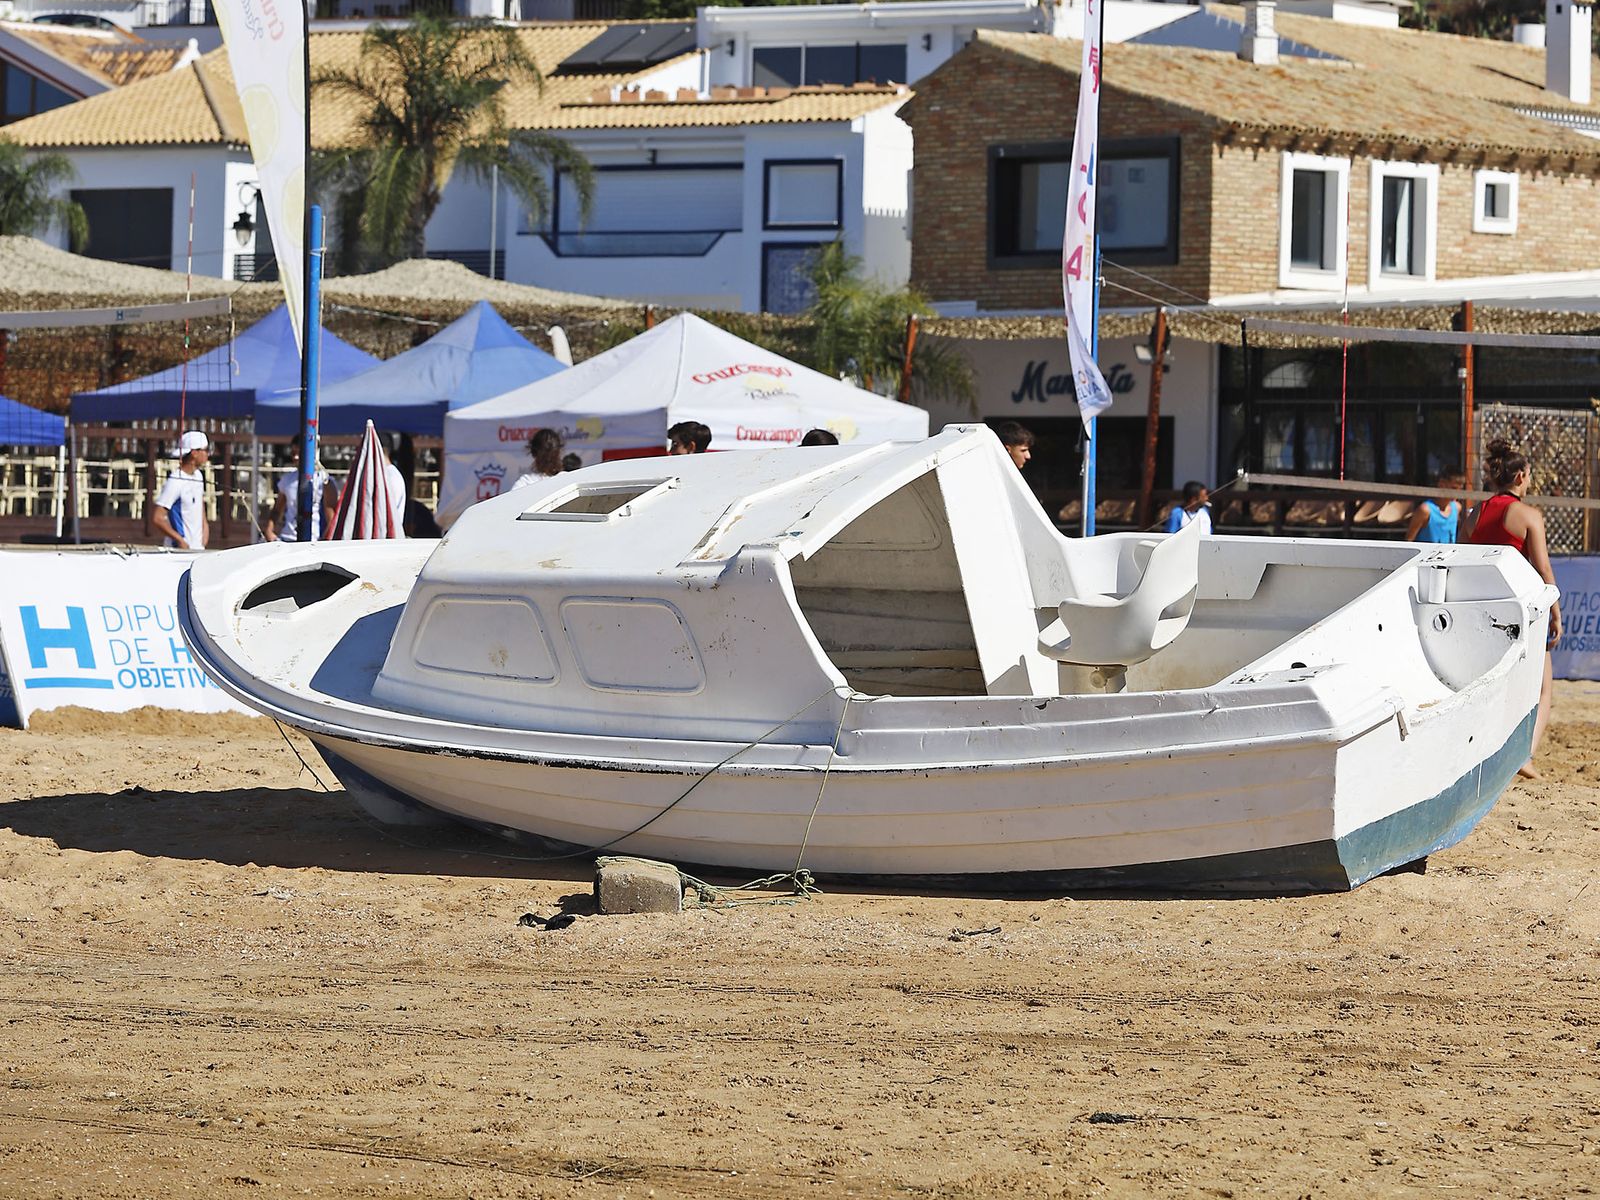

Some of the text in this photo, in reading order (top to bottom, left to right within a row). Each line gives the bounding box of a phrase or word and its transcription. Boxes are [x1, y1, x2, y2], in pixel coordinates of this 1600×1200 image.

[1011, 360, 1135, 403] Manta
[736, 425, 803, 444] Cruzcampo
[1560, 591, 1600, 612] UTAC
[101, 604, 176, 632] DIPU
[109, 637, 193, 666] DE H
[117, 667, 207, 689] OBJETIV
